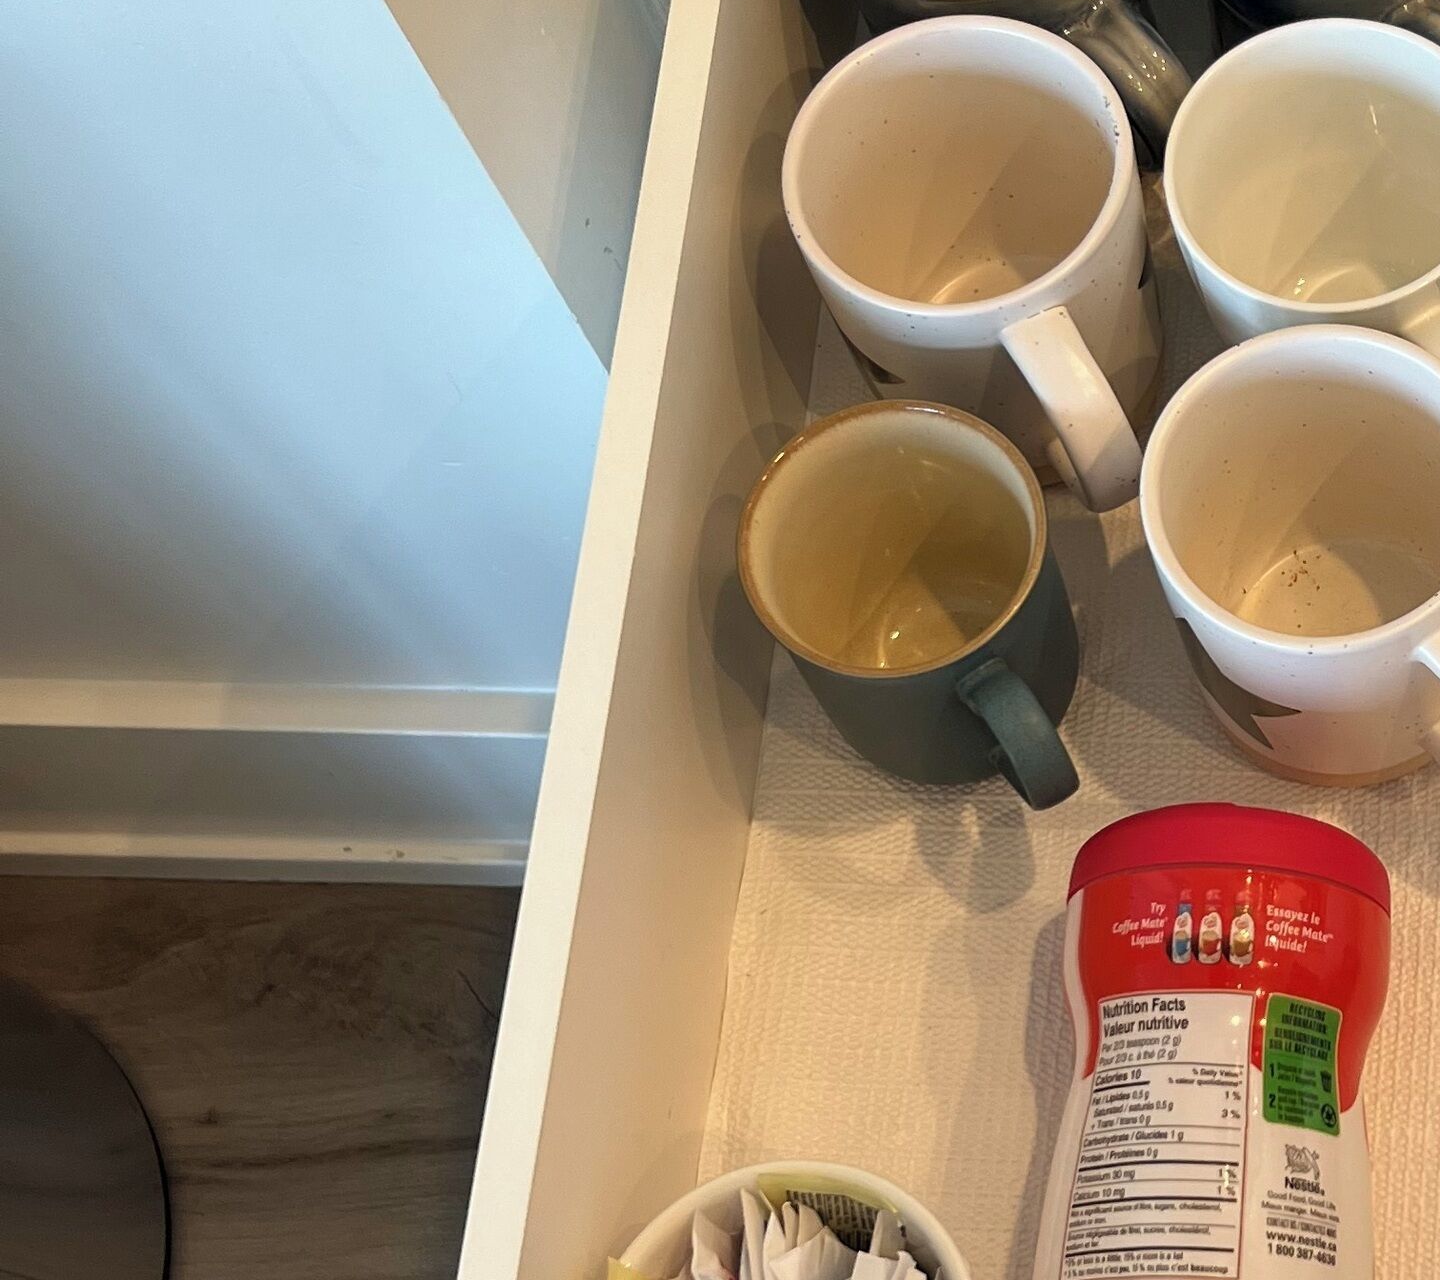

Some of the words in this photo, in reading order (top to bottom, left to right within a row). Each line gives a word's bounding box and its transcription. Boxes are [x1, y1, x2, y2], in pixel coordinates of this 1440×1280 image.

[1151, 902, 1166, 916] Try
[1266, 904, 1309, 922] Essayez
[1310, 912, 1320, 925] le
[1112, 919, 1139, 935] Coffee
[1266, 920, 1301, 936] Coffee
[1131, 931, 1164, 949] Liquid!
[1103, 1001, 1148, 1019] Nutrition
[1151, 998, 1186, 1012] Facts
[1104, 1020, 1136, 1038] Valeur
[1138, 1015, 1189, 1032] nutritive
[1095, 1072, 1129, 1087] Calories
[1131, 1068, 1142, 1080] 10
[1269, 1093, 1276, 1108] 2
[1266, 1230, 1337, 1252] www.nestle.ca
[1276, 1244, 1295, 1258] 800
